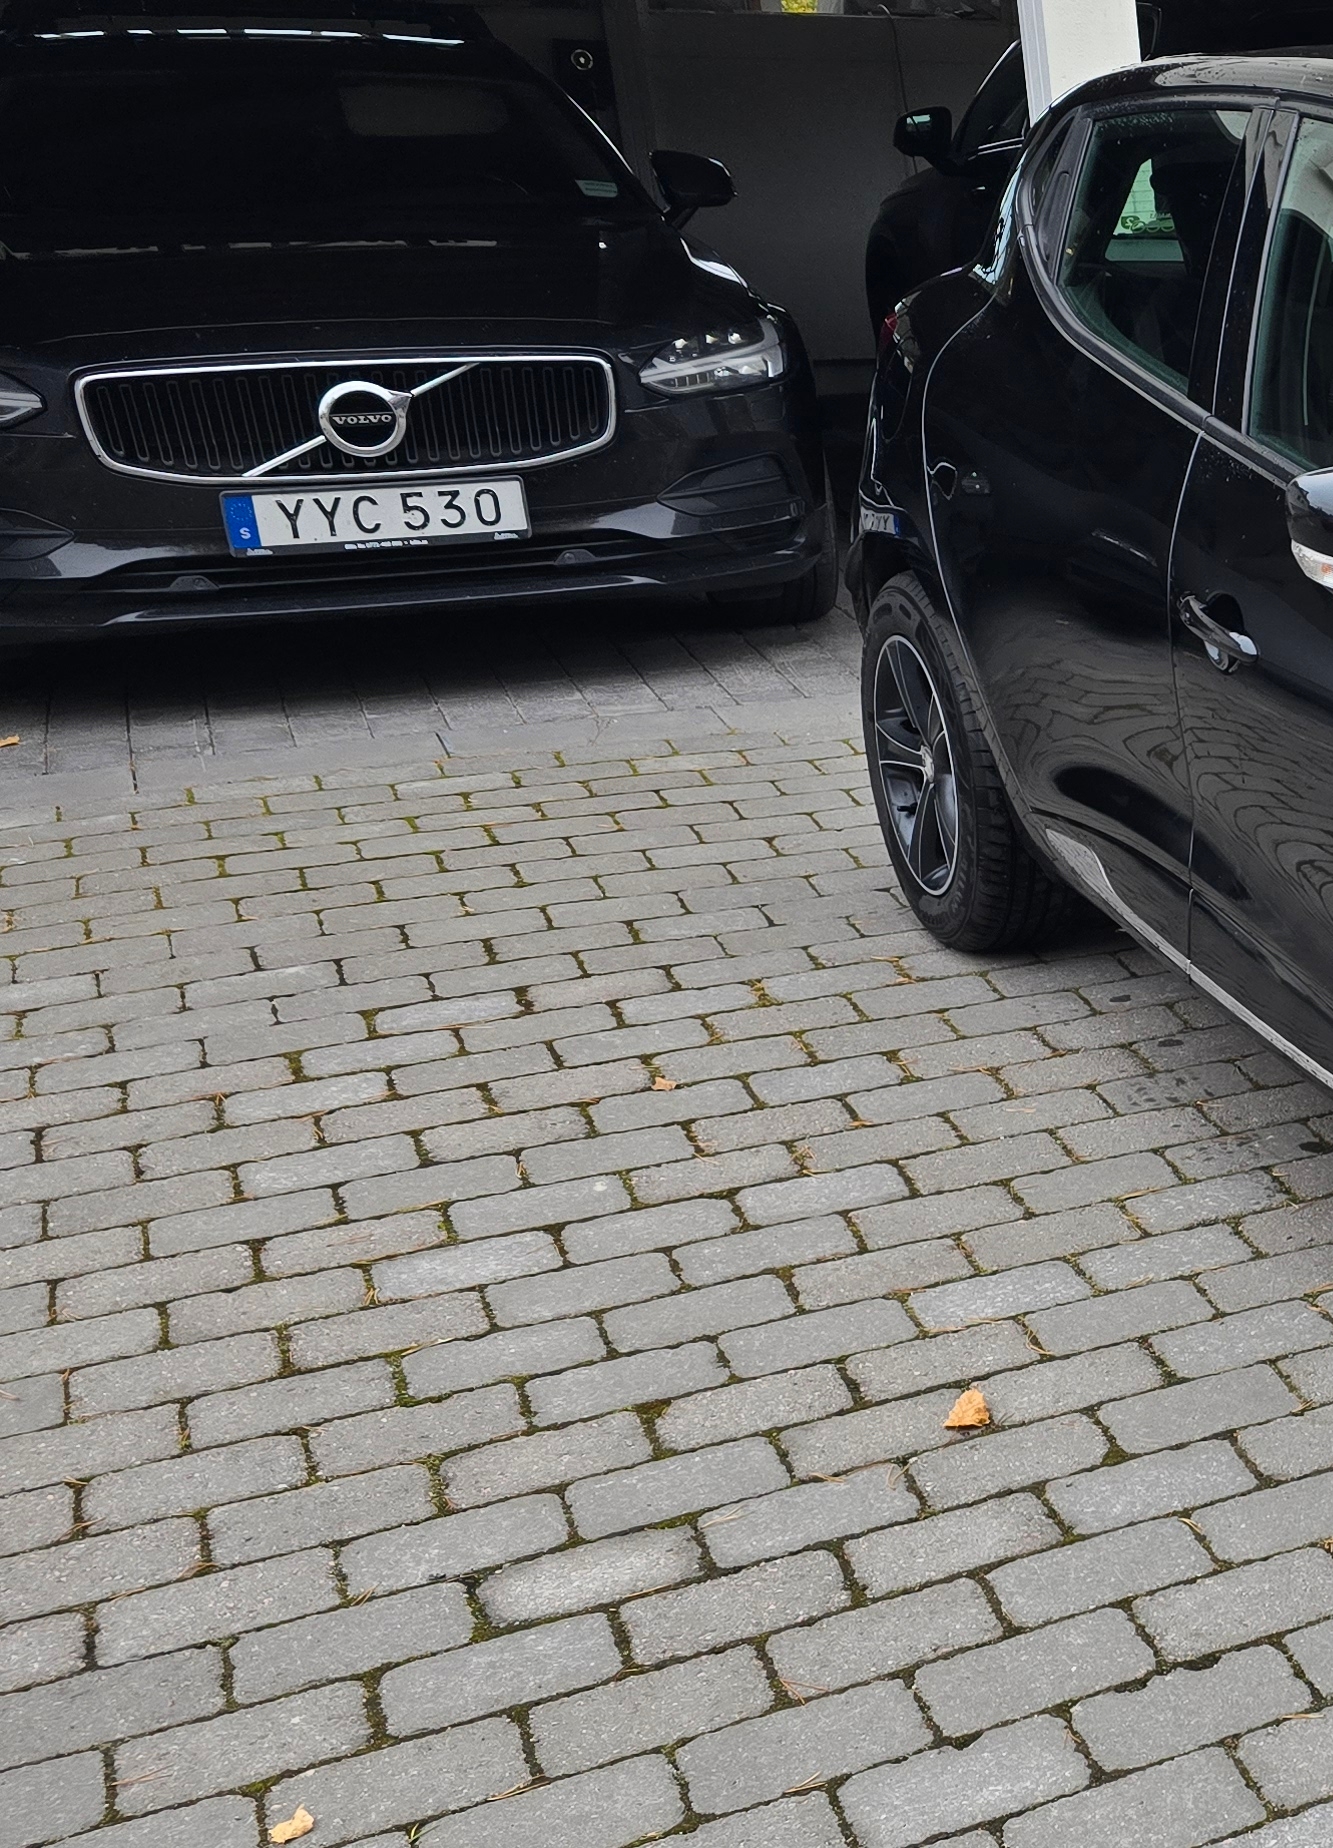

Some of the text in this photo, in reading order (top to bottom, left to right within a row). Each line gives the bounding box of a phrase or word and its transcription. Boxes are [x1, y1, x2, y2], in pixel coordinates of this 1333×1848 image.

[332, 413, 393, 426] VOLVO
[275, 488, 502, 539] YYC 530
[239, 527, 251, 540] S
